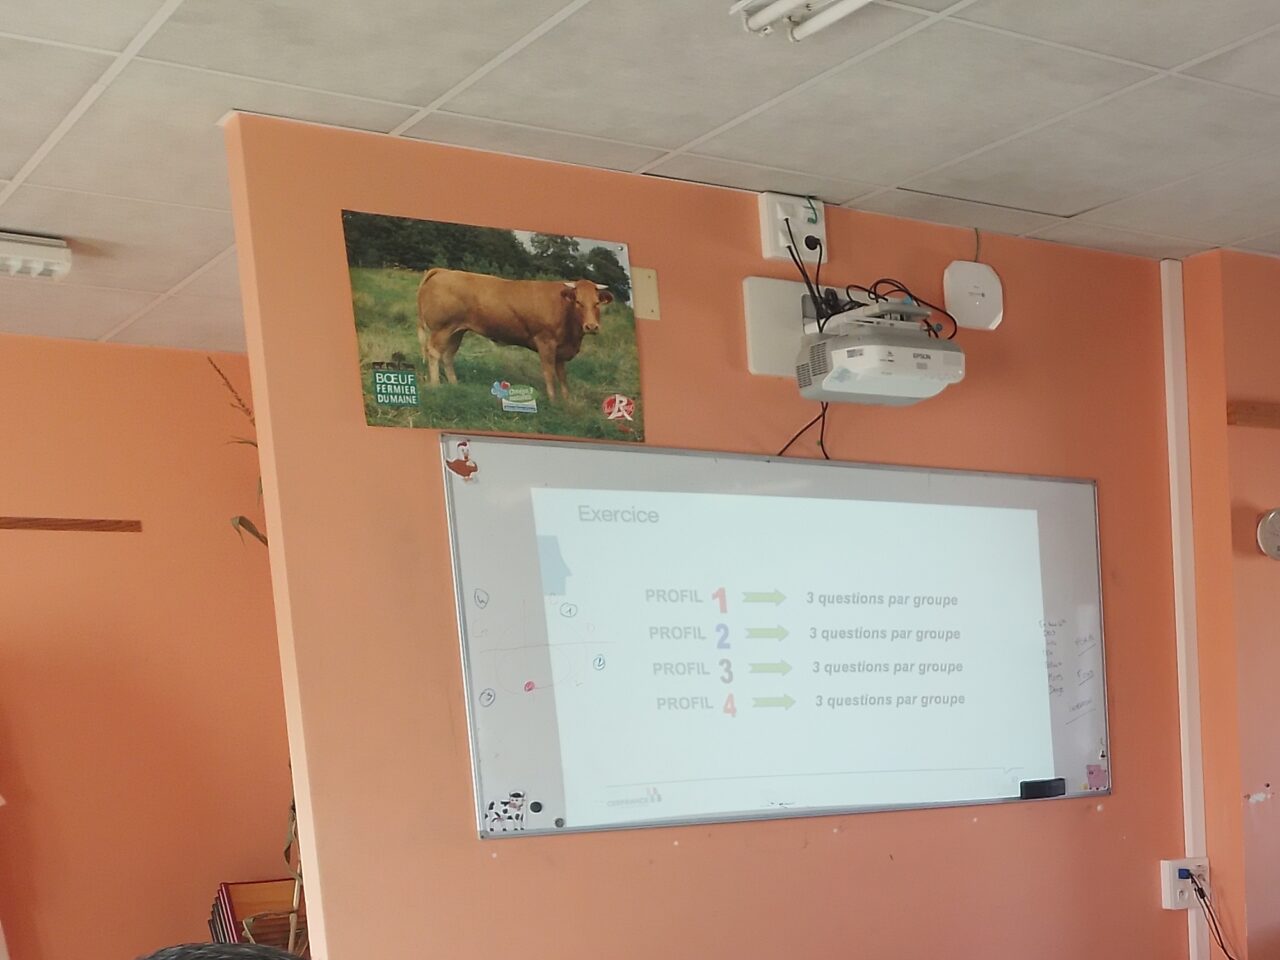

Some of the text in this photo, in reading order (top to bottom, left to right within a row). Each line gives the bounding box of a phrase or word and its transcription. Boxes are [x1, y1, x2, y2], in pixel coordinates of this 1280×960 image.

[376, 373, 414, 384] BŒUF
[377, 384, 416, 394] FERMIER
[578, 505, 660, 523] Exercice
[645, 587, 959, 613] PROFIL 1 3 questions par groupe
[648, 623, 961, 649] PROFIL 2 3 questions par groupe
[652, 658, 964, 684] PROFIL 3 3 questions par groupe
[656, 692, 966, 717] PROFIL 4 3 questions par groupe
